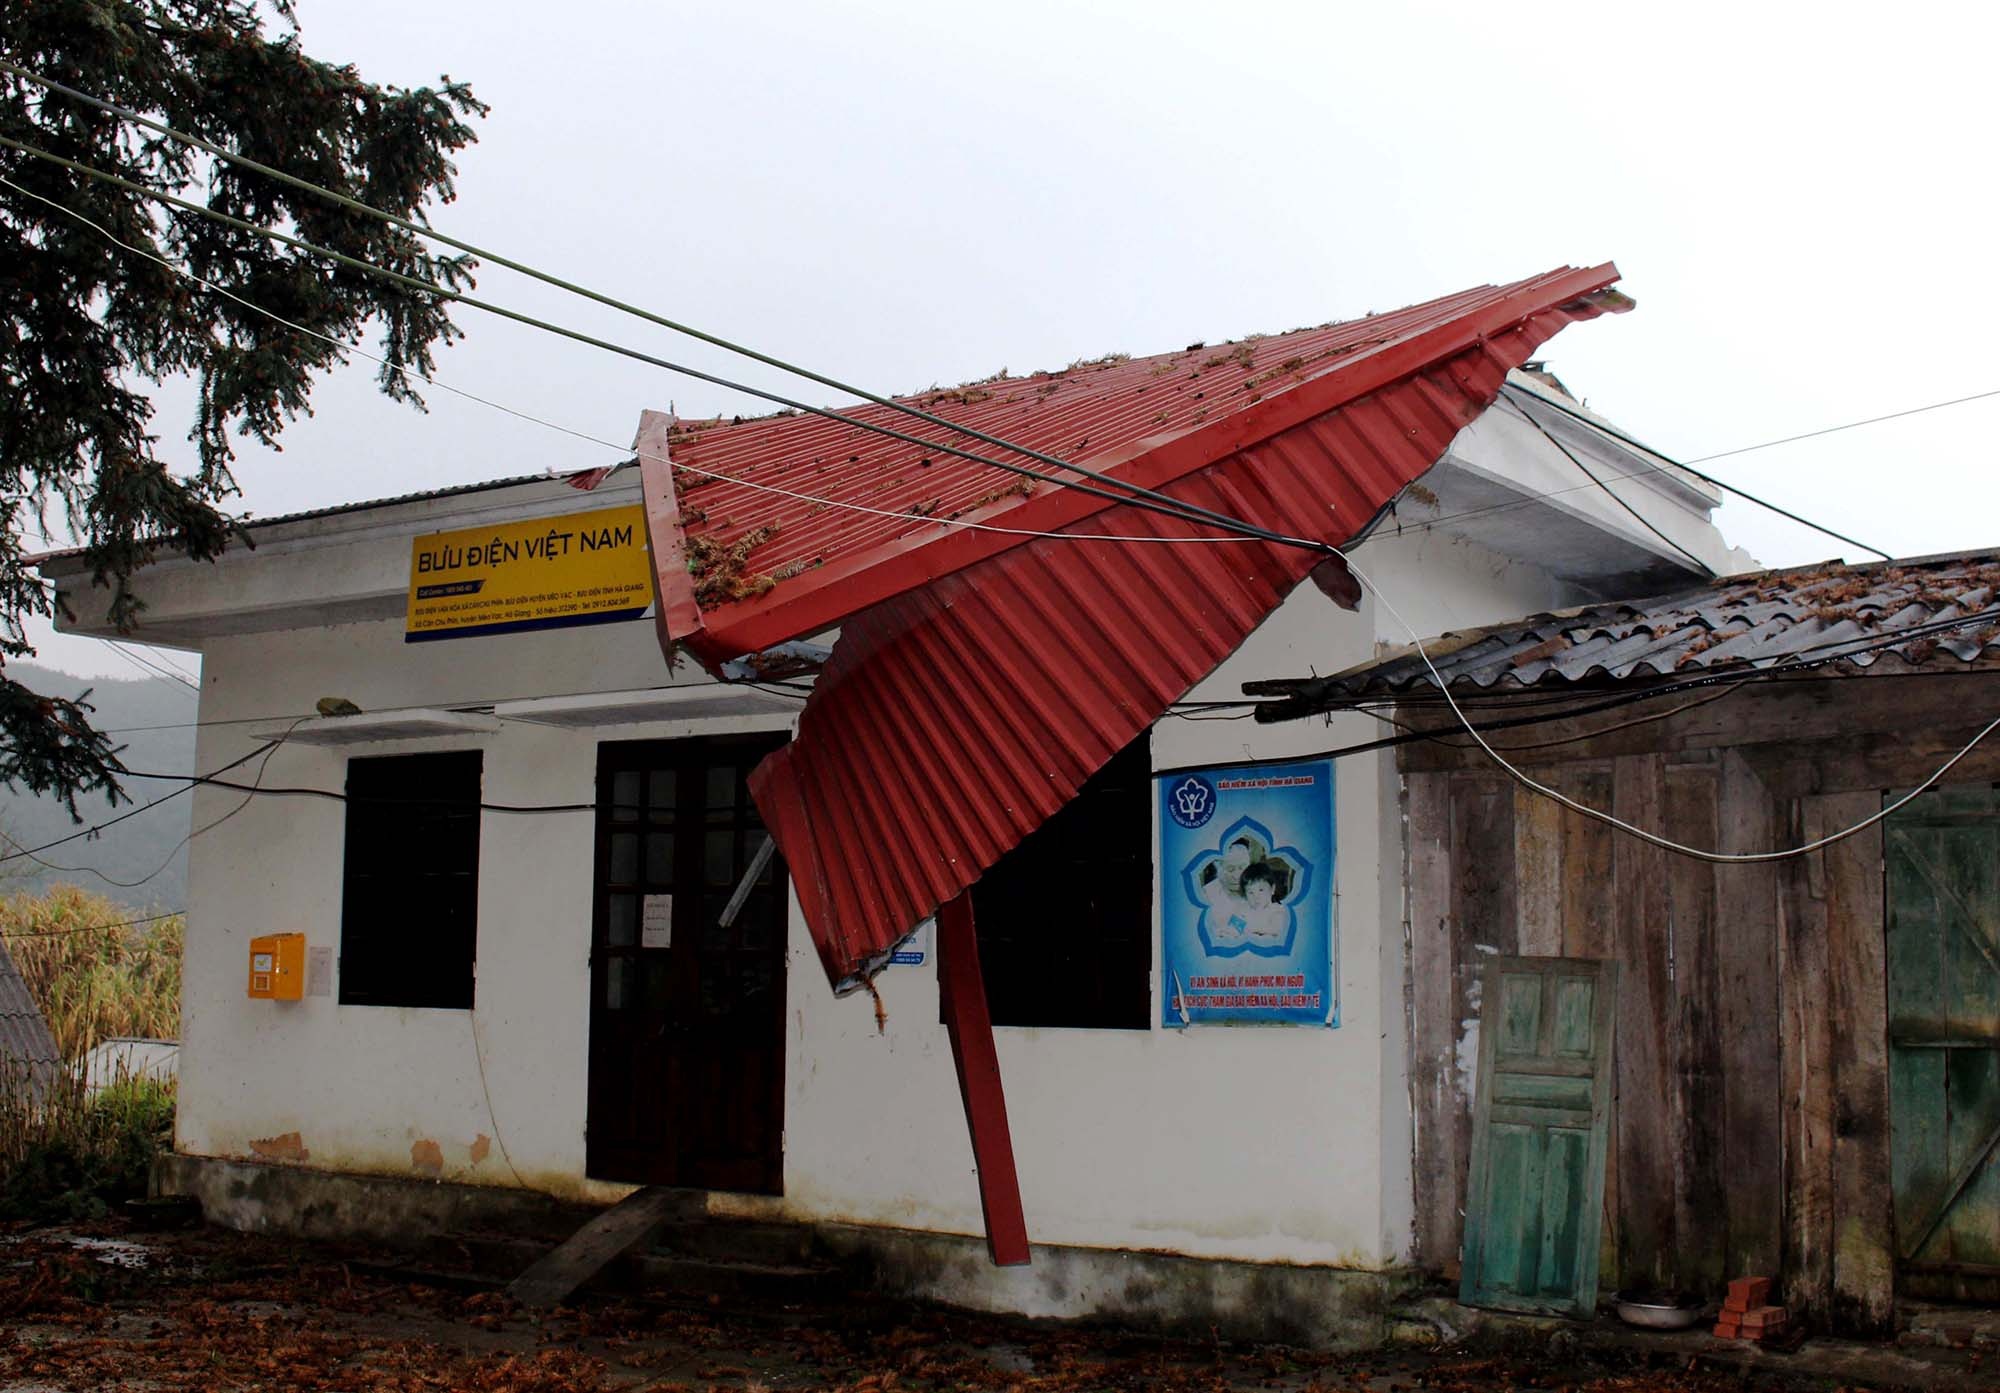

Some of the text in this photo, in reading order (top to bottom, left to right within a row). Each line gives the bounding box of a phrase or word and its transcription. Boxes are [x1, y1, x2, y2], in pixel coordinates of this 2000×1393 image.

[466, 536, 519, 568] ĐIỆN
[524, 528, 574, 561] VIỆT
[580, 524, 633, 553] NAM
